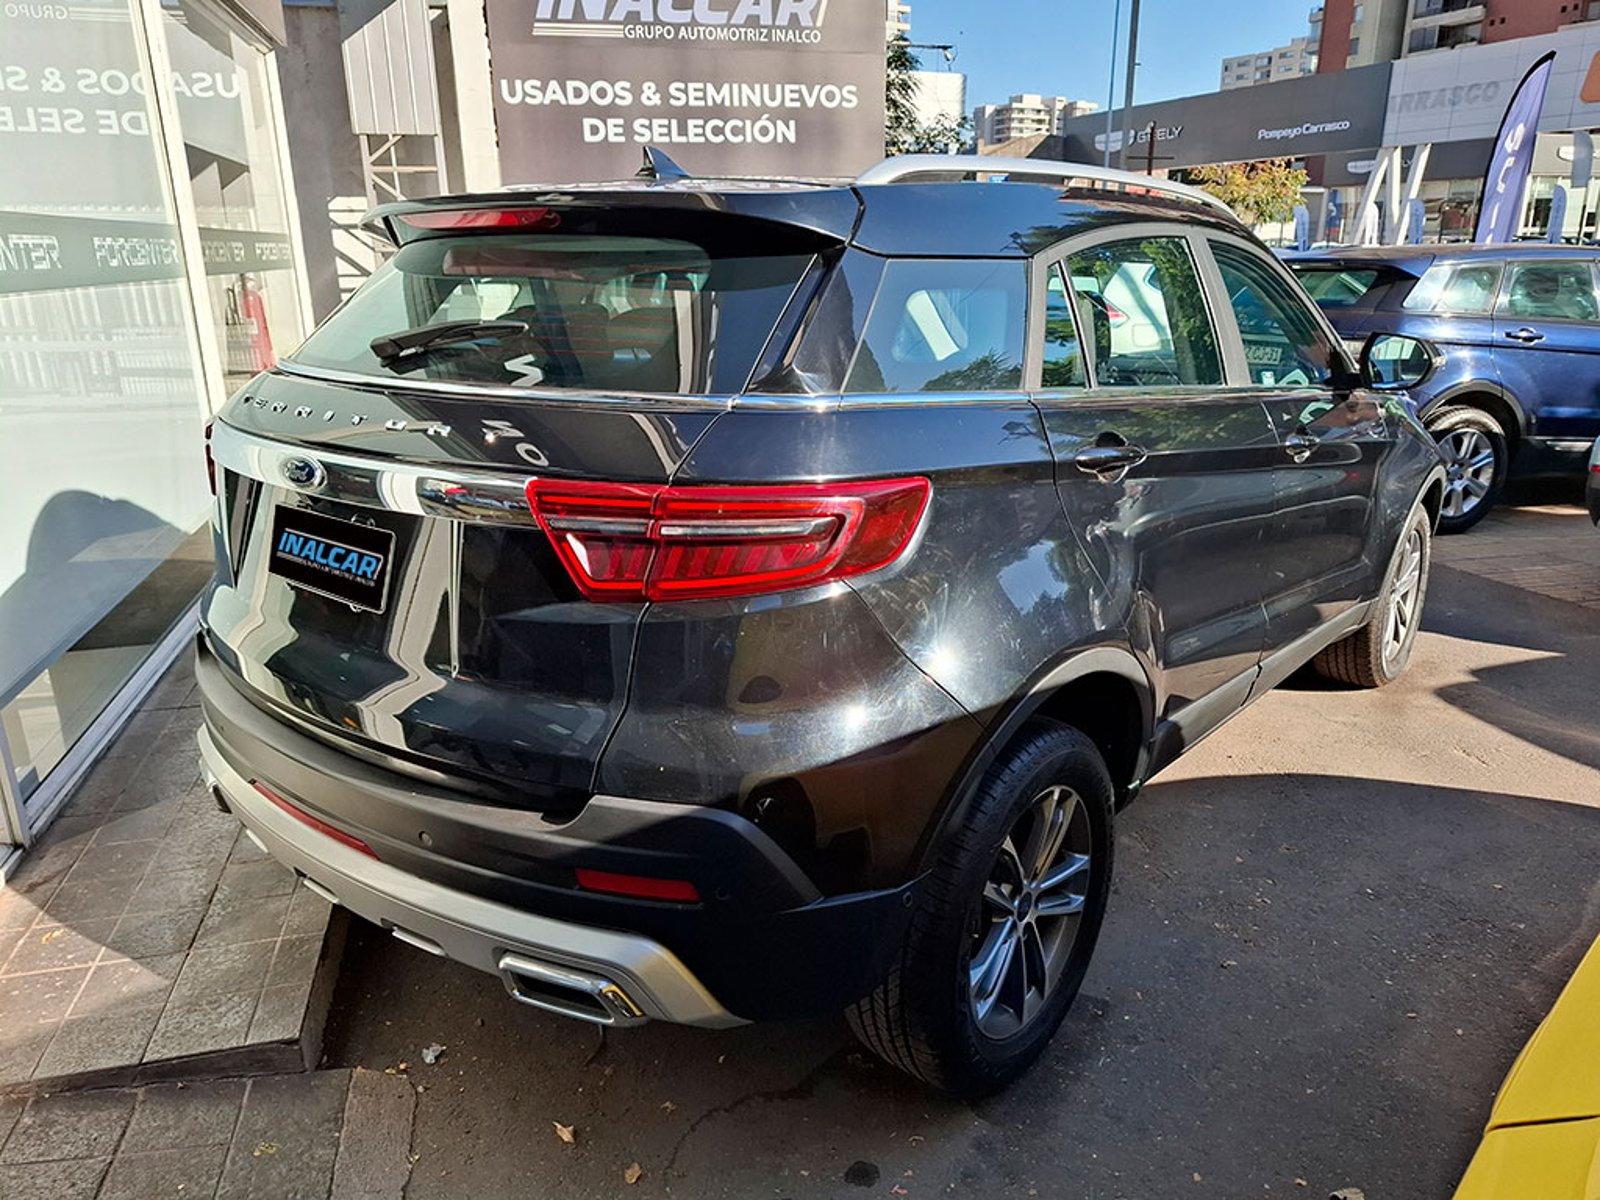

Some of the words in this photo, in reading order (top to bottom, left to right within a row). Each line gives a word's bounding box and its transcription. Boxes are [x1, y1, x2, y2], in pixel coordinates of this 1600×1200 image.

[624, 24, 674, 39] GRUPO
[678, 26, 768, 41] AUTOMOTRIZ
[771, 28, 821, 43] INALCO
[501, 79, 631, 107] USADOS
[640, 82, 661, 107] &
[669, 82, 858, 109] SEMINUEVOS
[583, 118, 626, 143] DE
[633, 114, 796, 143] SELECCIÓN
[278, 531, 378, 579] INALCAR
